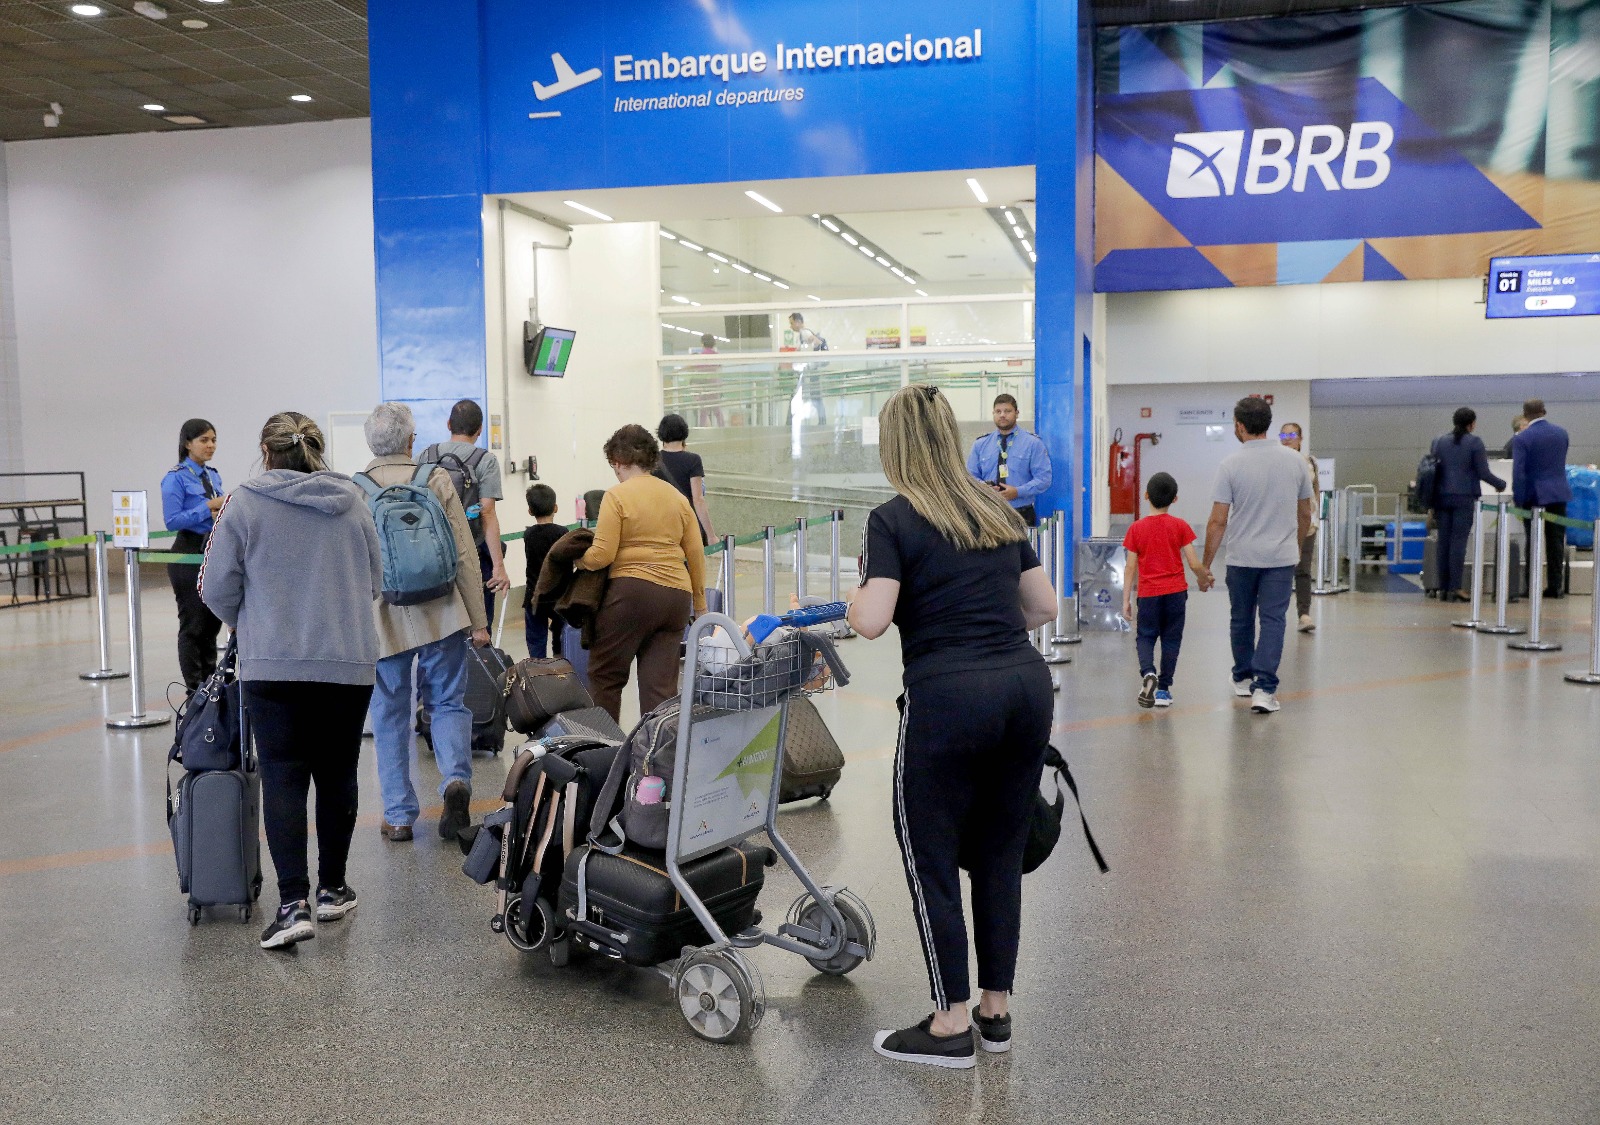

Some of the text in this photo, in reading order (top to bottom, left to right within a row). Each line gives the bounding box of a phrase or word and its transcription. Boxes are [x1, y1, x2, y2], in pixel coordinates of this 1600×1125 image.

[613, 28, 982, 83] Embarque Internacional
[613, 87, 804, 112] International departures
[1244, 121, 1394, 195] BRB
[1499, 278, 1517, 292] 01
[1527, 277, 1576, 286] MILES & GO
